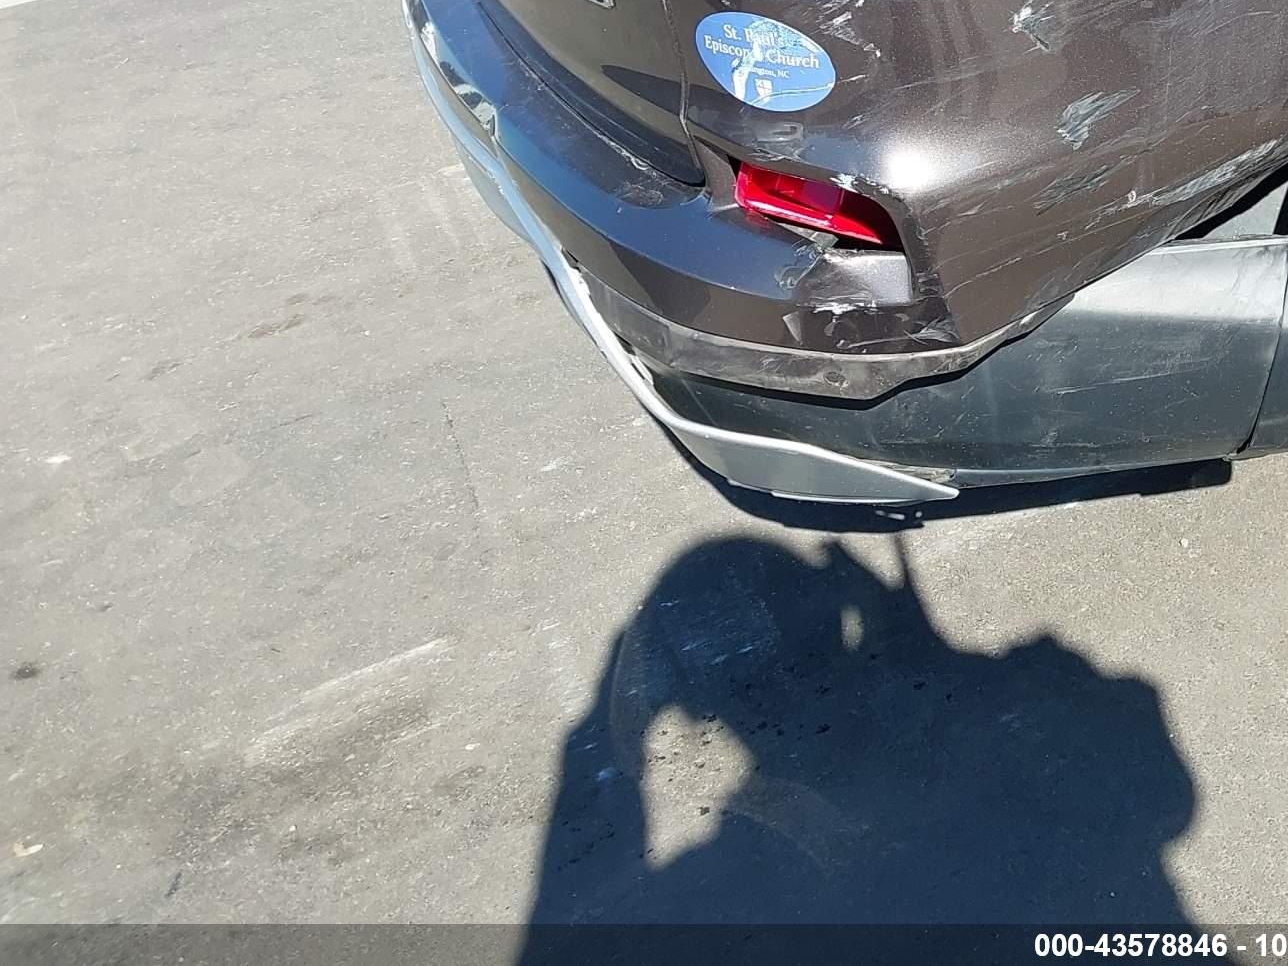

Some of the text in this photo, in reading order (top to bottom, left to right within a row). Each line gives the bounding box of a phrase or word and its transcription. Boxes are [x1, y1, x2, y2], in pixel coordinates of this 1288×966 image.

[723, 24, 742, 41] St.
[766, 48, 820, 68] Church
[777, 70, 791, 79] NC
